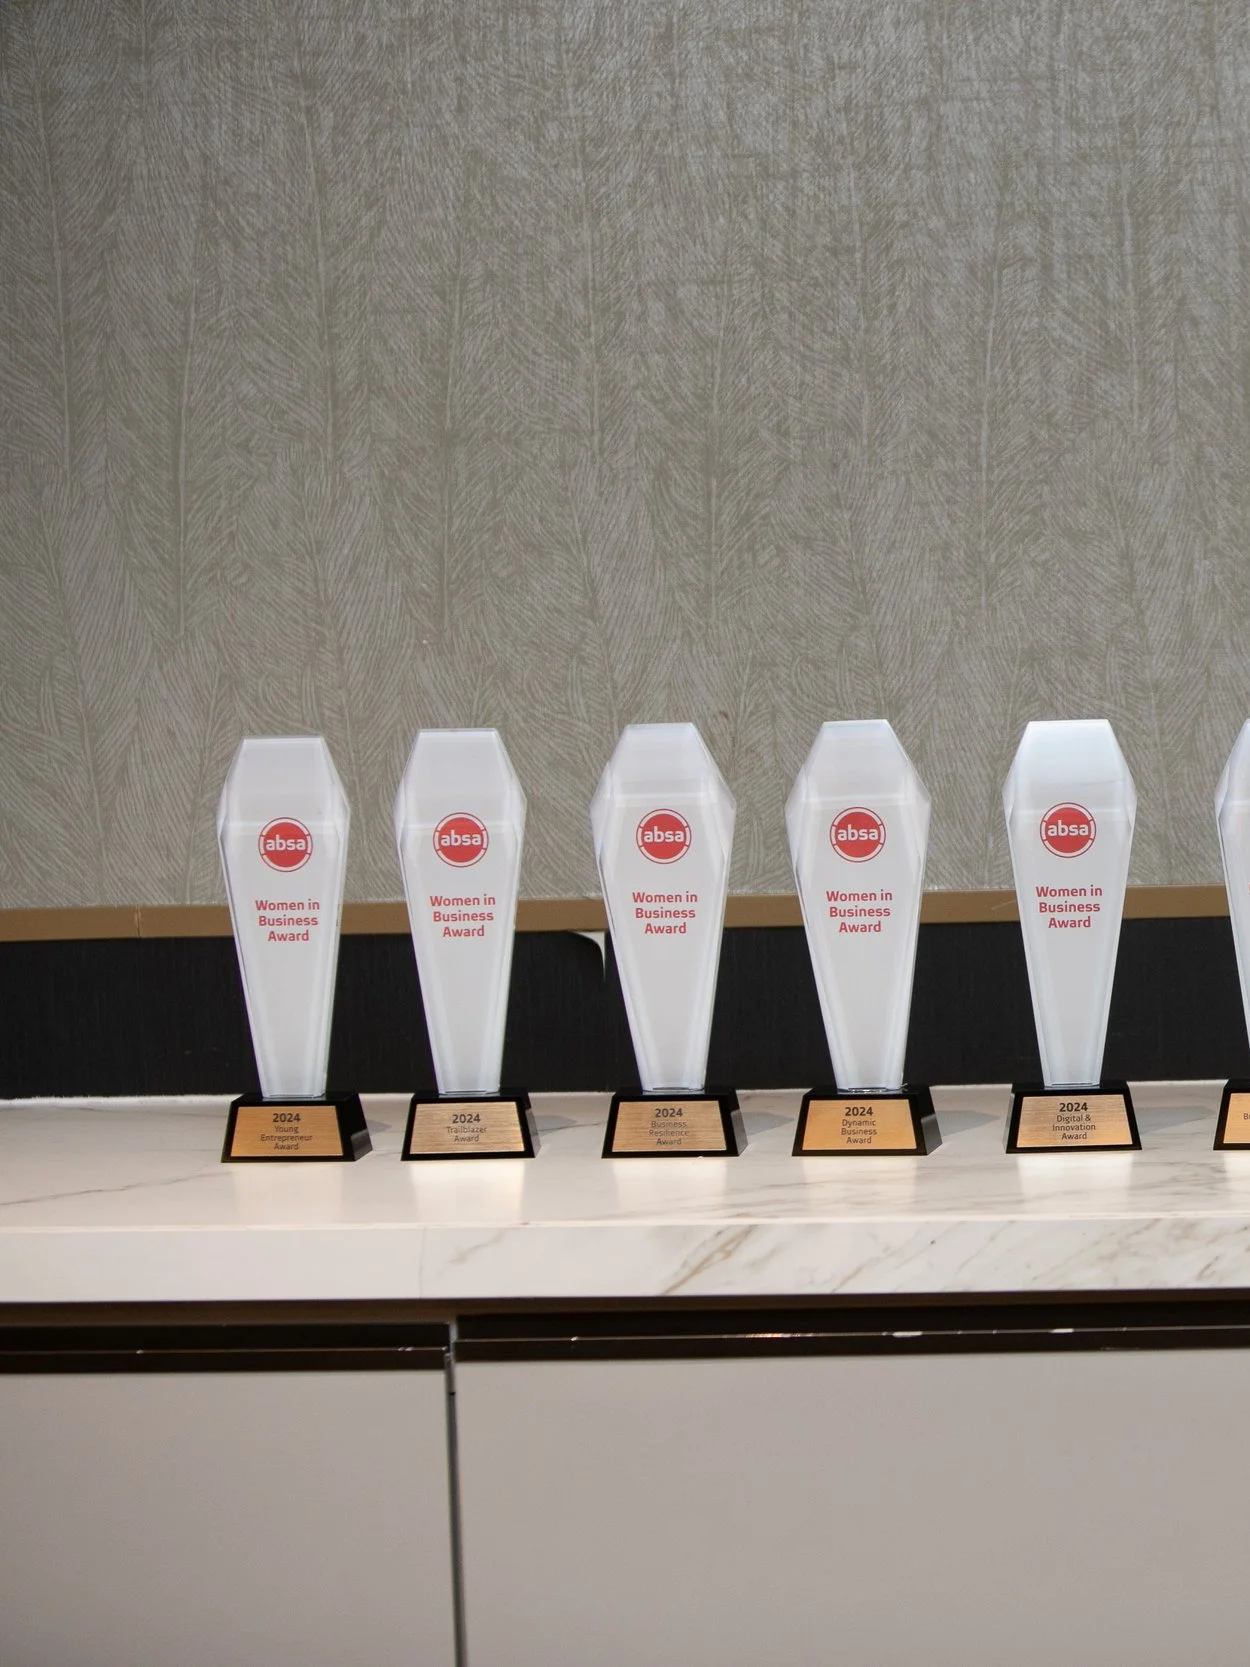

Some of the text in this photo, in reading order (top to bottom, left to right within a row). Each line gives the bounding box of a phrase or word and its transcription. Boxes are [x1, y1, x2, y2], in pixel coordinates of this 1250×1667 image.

[643, 826, 685, 843] absa
[836, 825, 879, 841] absa
[1047, 820, 1089, 837] absa
[265, 835, 306, 850] absa
[440, 830, 481, 846] absa
[632, 891, 698, 903] Women in
[826, 889, 892, 902] Women in
[1035, 885, 1103, 897] Women in
[254, 898, 320, 911] Women in
[429, 894, 496, 907] Women in
[1039, 900, 1100, 913] Business
[432, 910, 494, 922] Business
[635, 907, 696, 919] Business
[829, 905, 891, 918] Business
[259, 914, 319, 927] Business
[838, 920, 881, 933] Award
[1048, 916, 1092, 928] Award
[442, 925, 485, 937] Award
[644, 922, 687, 935] Award
[268, 929, 310, 941] Award
[655, 1108, 683, 1118] 2024
[844, 1106, 873, 1117] 2024
[1059, 1102, 1088, 1112] 2024
[272, 1113, 300, 1123] 2024
[452, 1114, 481, 1124] 2024
[651, 1120, 687, 1128] Business
[842, 1119, 876, 1128] Dynamic
[1056, 1114, 1091, 1124] Digital &
[274, 1125, 299, 1134] Young
[446, 1125, 487, 1134] Trailblazer
[841, 1128, 877, 1136] Business
[1052, 1123, 1096, 1131] Innovation
[260, 1134, 312, 1143] Entrepreneur
[454, 1134, 479, 1143] Award
[656, 1137, 682, 1146] Award
[846, 1136, 872, 1145] Award
[1061, 1131, 1087, 1140] Award
[274, 1142, 299, 1151] Award
